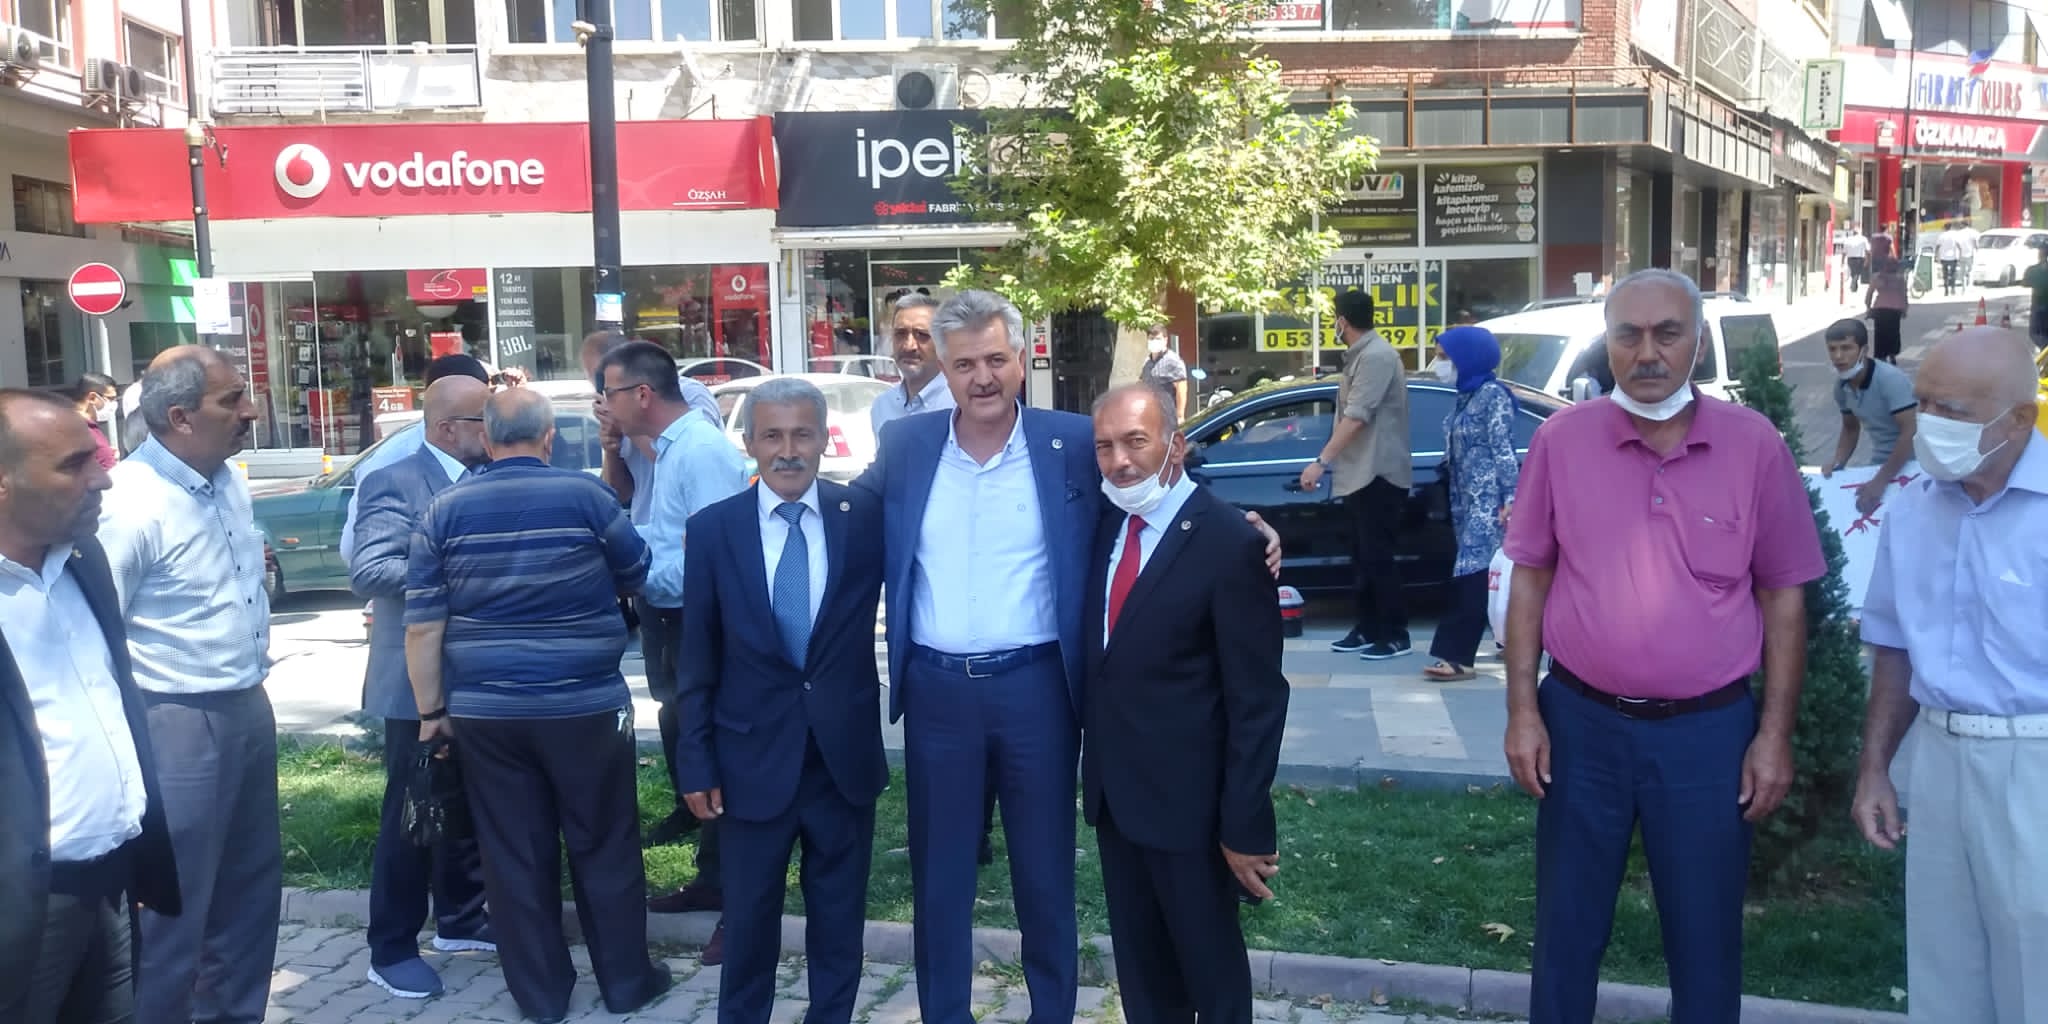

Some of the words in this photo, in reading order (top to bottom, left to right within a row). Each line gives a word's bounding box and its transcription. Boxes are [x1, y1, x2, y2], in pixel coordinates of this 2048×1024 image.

[1281, 5, 1296, 19] 33
[1301, 5, 1317, 19] 77
[1982, 80, 2022, 112] KURS
[343, 150, 545, 188] vodafone
[1451, 174, 1477, 185] kitap
[687, 188, 727, 201] ÖZŞAH
[1433, 183, 1485, 194] kafemizde
[1352, 262, 1439, 275] FRMALARA
[499, 273, 513, 284] 12
[1267, 284, 1439, 310] KİRLIK
[1266, 332, 1278, 348] 0
[378, 398, 389, 412] 4
